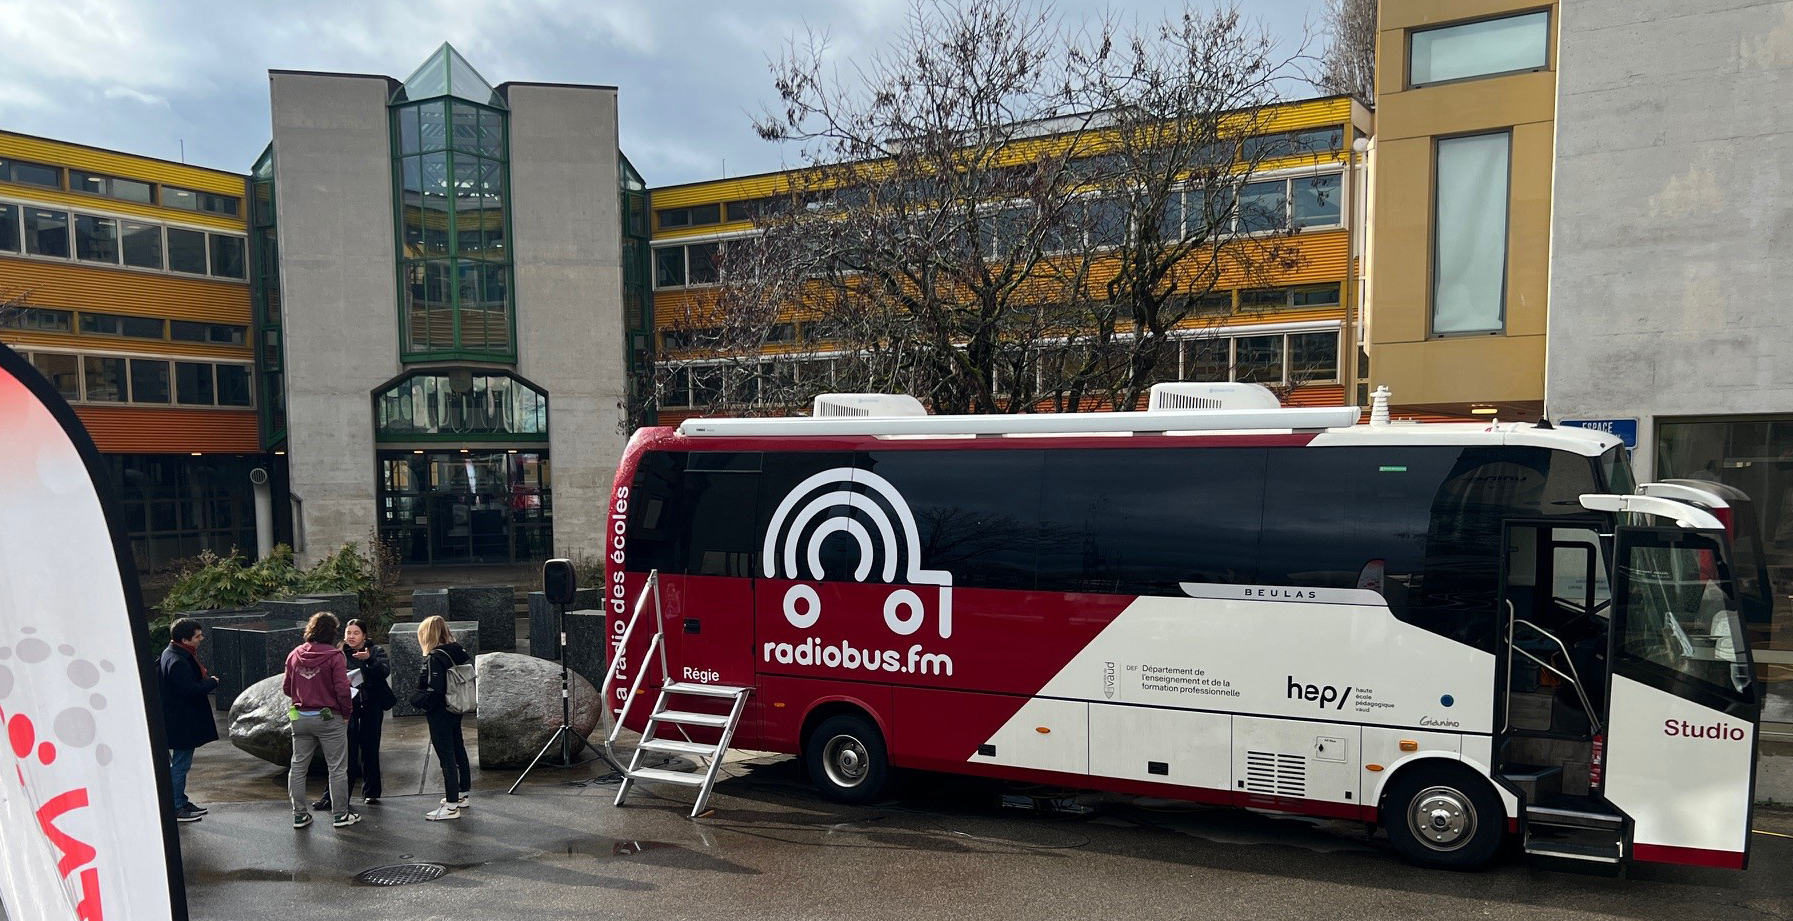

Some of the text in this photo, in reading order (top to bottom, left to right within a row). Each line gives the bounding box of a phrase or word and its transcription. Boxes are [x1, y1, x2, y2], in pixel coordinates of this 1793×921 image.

[611, 486, 629, 564] écoles
[611, 571, 625, 614] des
[1244, 588, 1316, 599] BEULAS
[763, 636, 953, 677] radiobus.fm
[683, 666, 720, 683] Régie
[1104, 662, 1115, 687] vaud
[1142, 664, 1193, 676] Département
[1141, 682, 1241, 697] formation professionnelle
[1211, 678, 1221, 686] de
[1223, 679, 1230, 687] la
[1355, 700, 1395, 709] pédagogique
[1664, 719, 1744, 741] Studio
